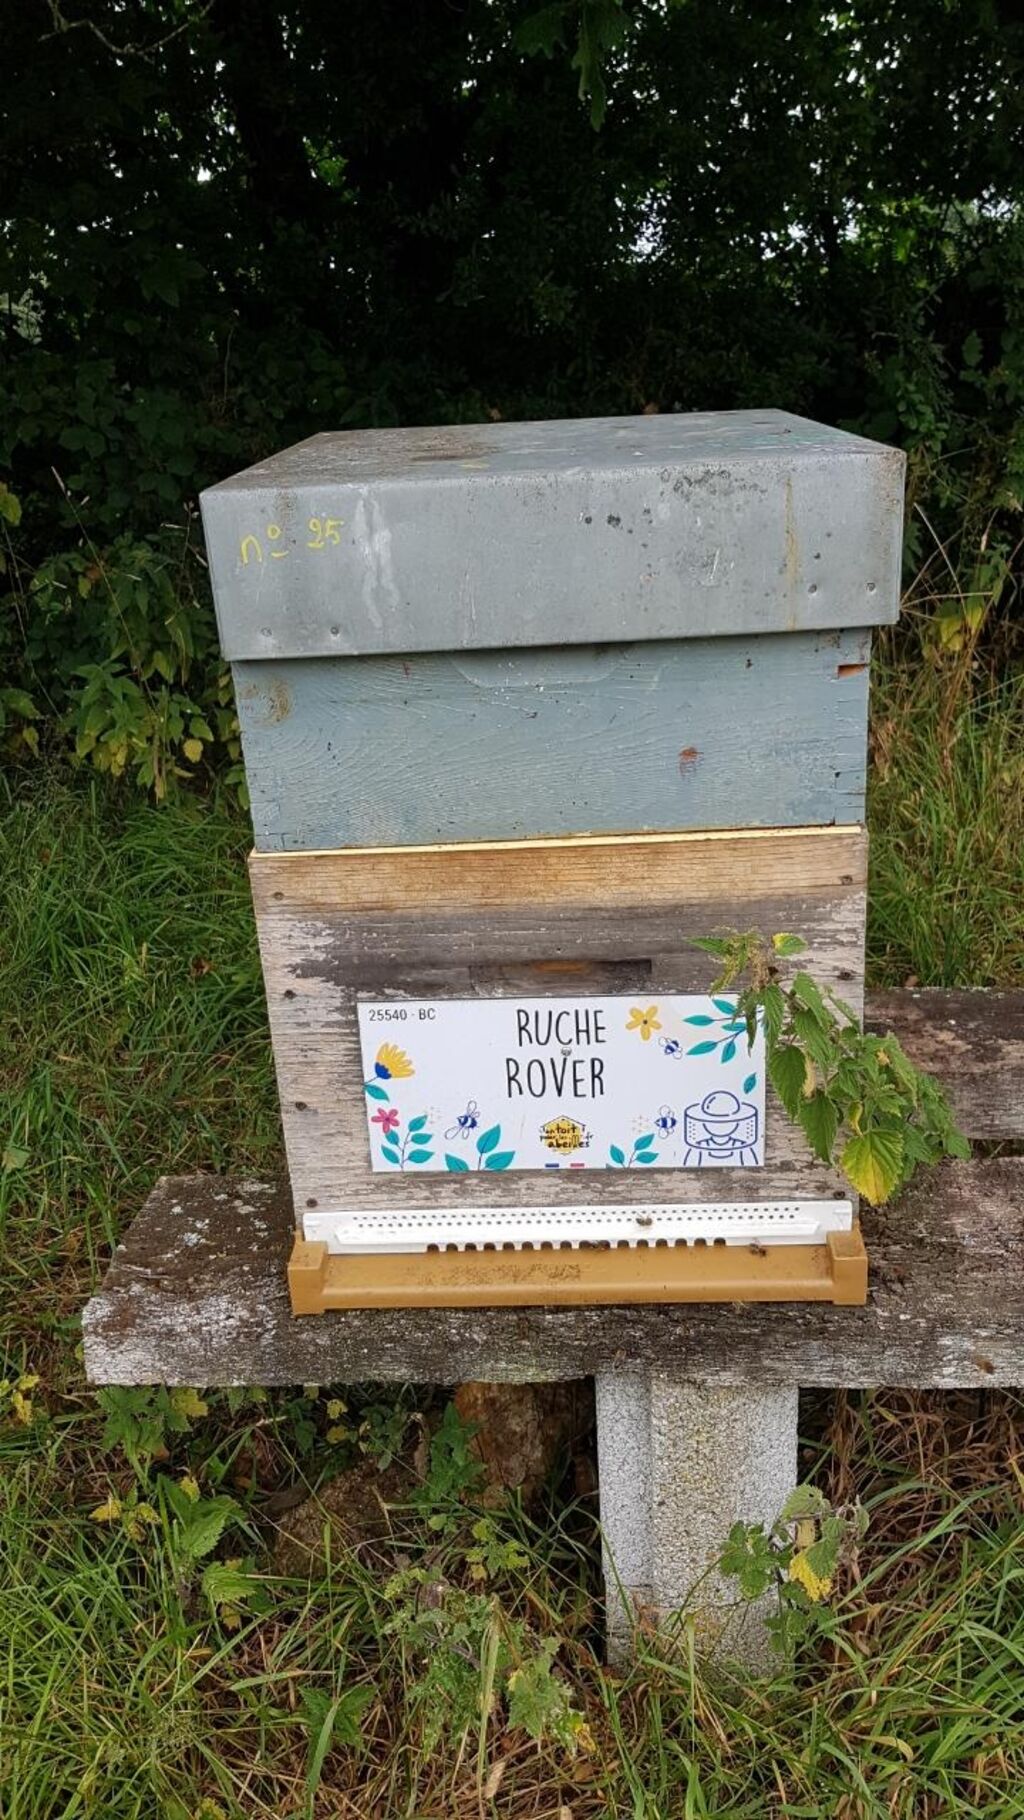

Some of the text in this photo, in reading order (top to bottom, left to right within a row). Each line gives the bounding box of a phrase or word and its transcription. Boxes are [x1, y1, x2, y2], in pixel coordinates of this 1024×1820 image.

[368, 1009, 408, 1022] 25540
[418, 1008, 436, 1021] BC
[516, 1008, 607, 1047] RUCHE
[505, 1057, 606, 1099] ROVER
